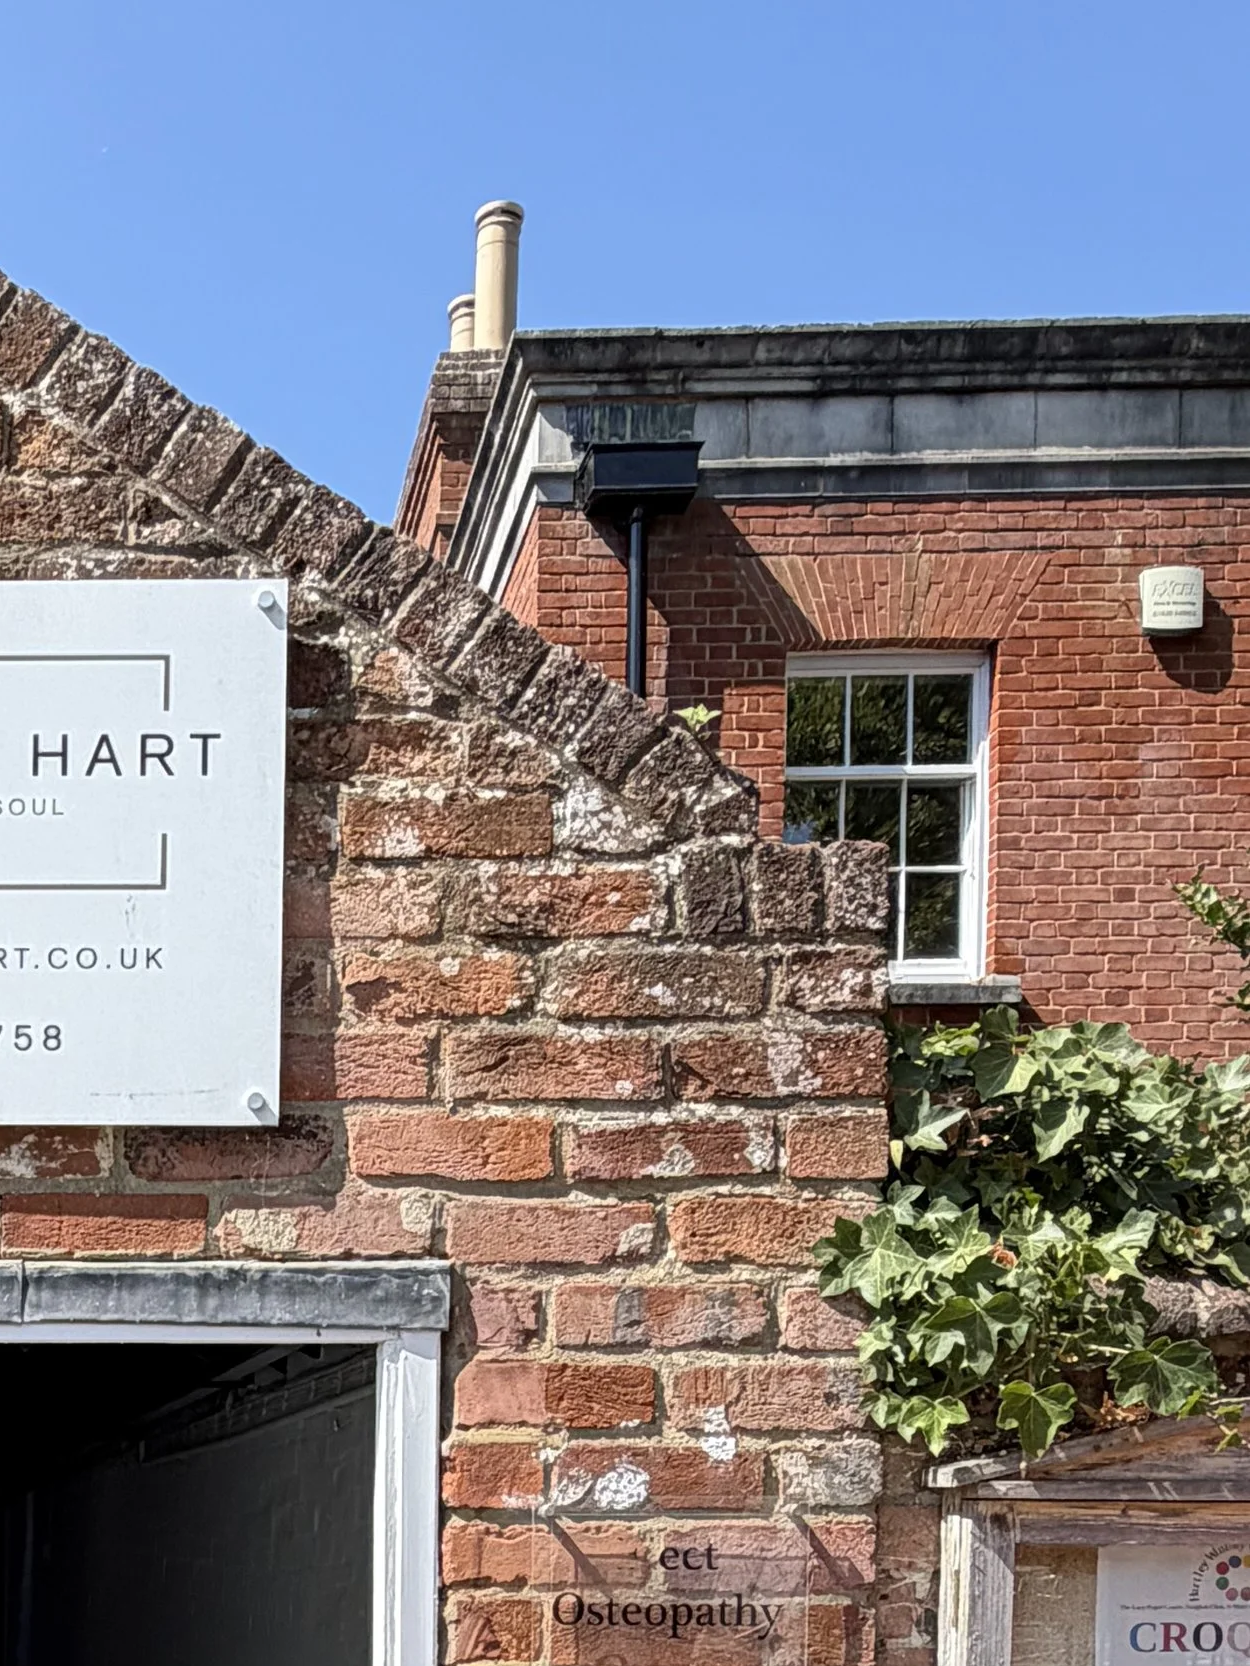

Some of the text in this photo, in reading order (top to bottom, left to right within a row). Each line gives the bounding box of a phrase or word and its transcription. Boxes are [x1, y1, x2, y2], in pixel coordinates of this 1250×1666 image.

[31, 731, 224, 778] HART
[552, 1592, 784, 1640] Osteopathy
[1129, 1621, 1250, 1658] CROQ
